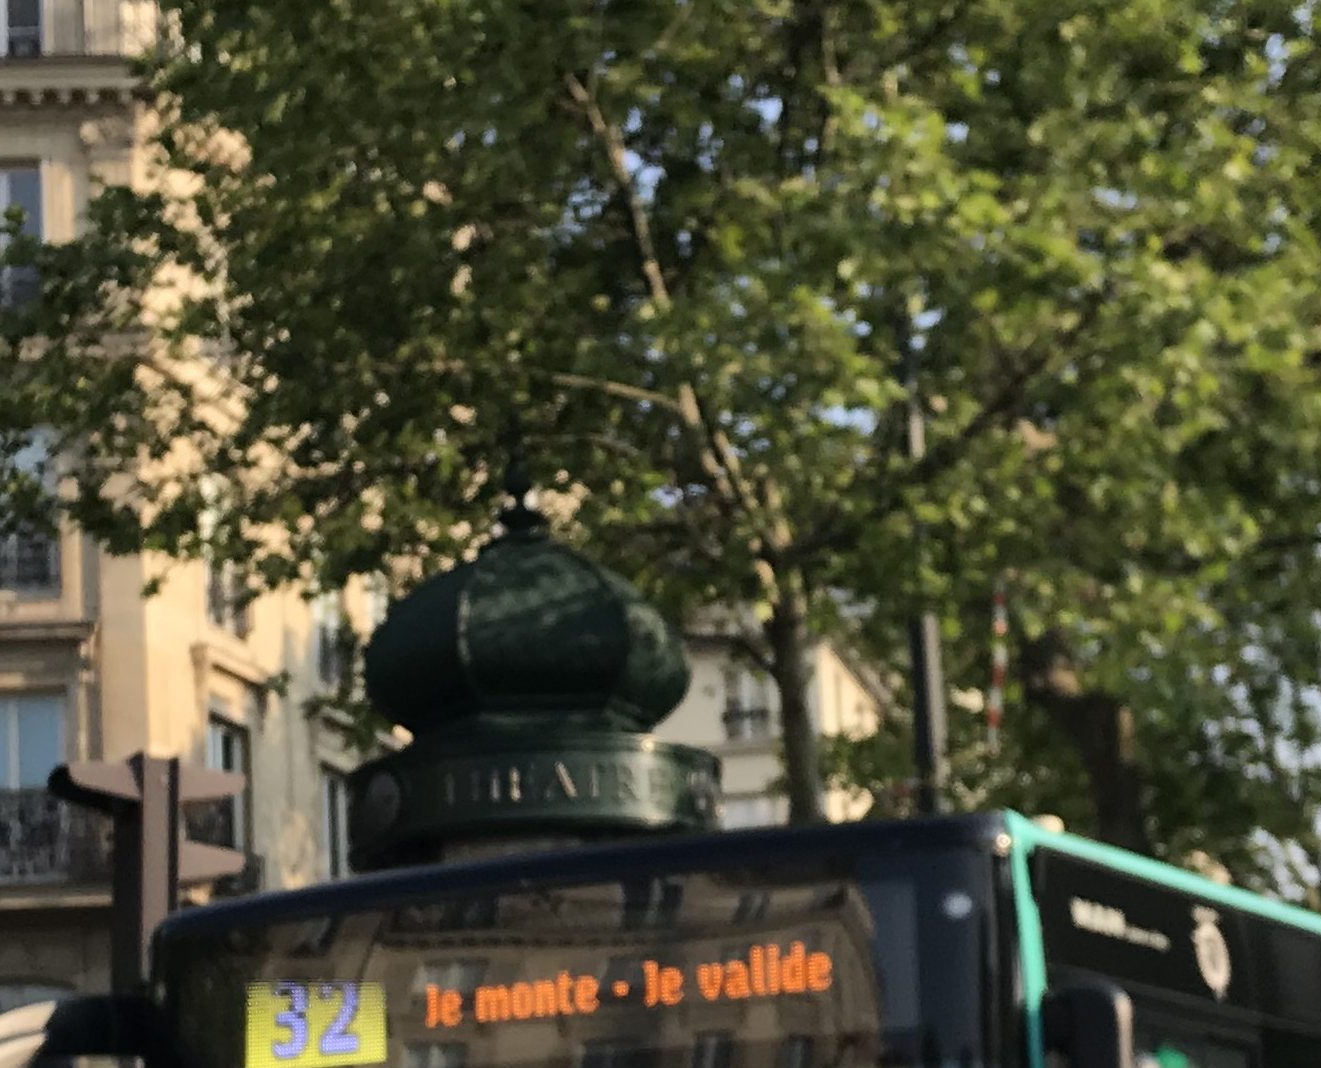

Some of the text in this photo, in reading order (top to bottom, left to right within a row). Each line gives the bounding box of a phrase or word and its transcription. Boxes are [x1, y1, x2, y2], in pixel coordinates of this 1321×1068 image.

[271, 980, 359, 1061] 32
[425, 940, 832, 1029] Je monte Je valide
